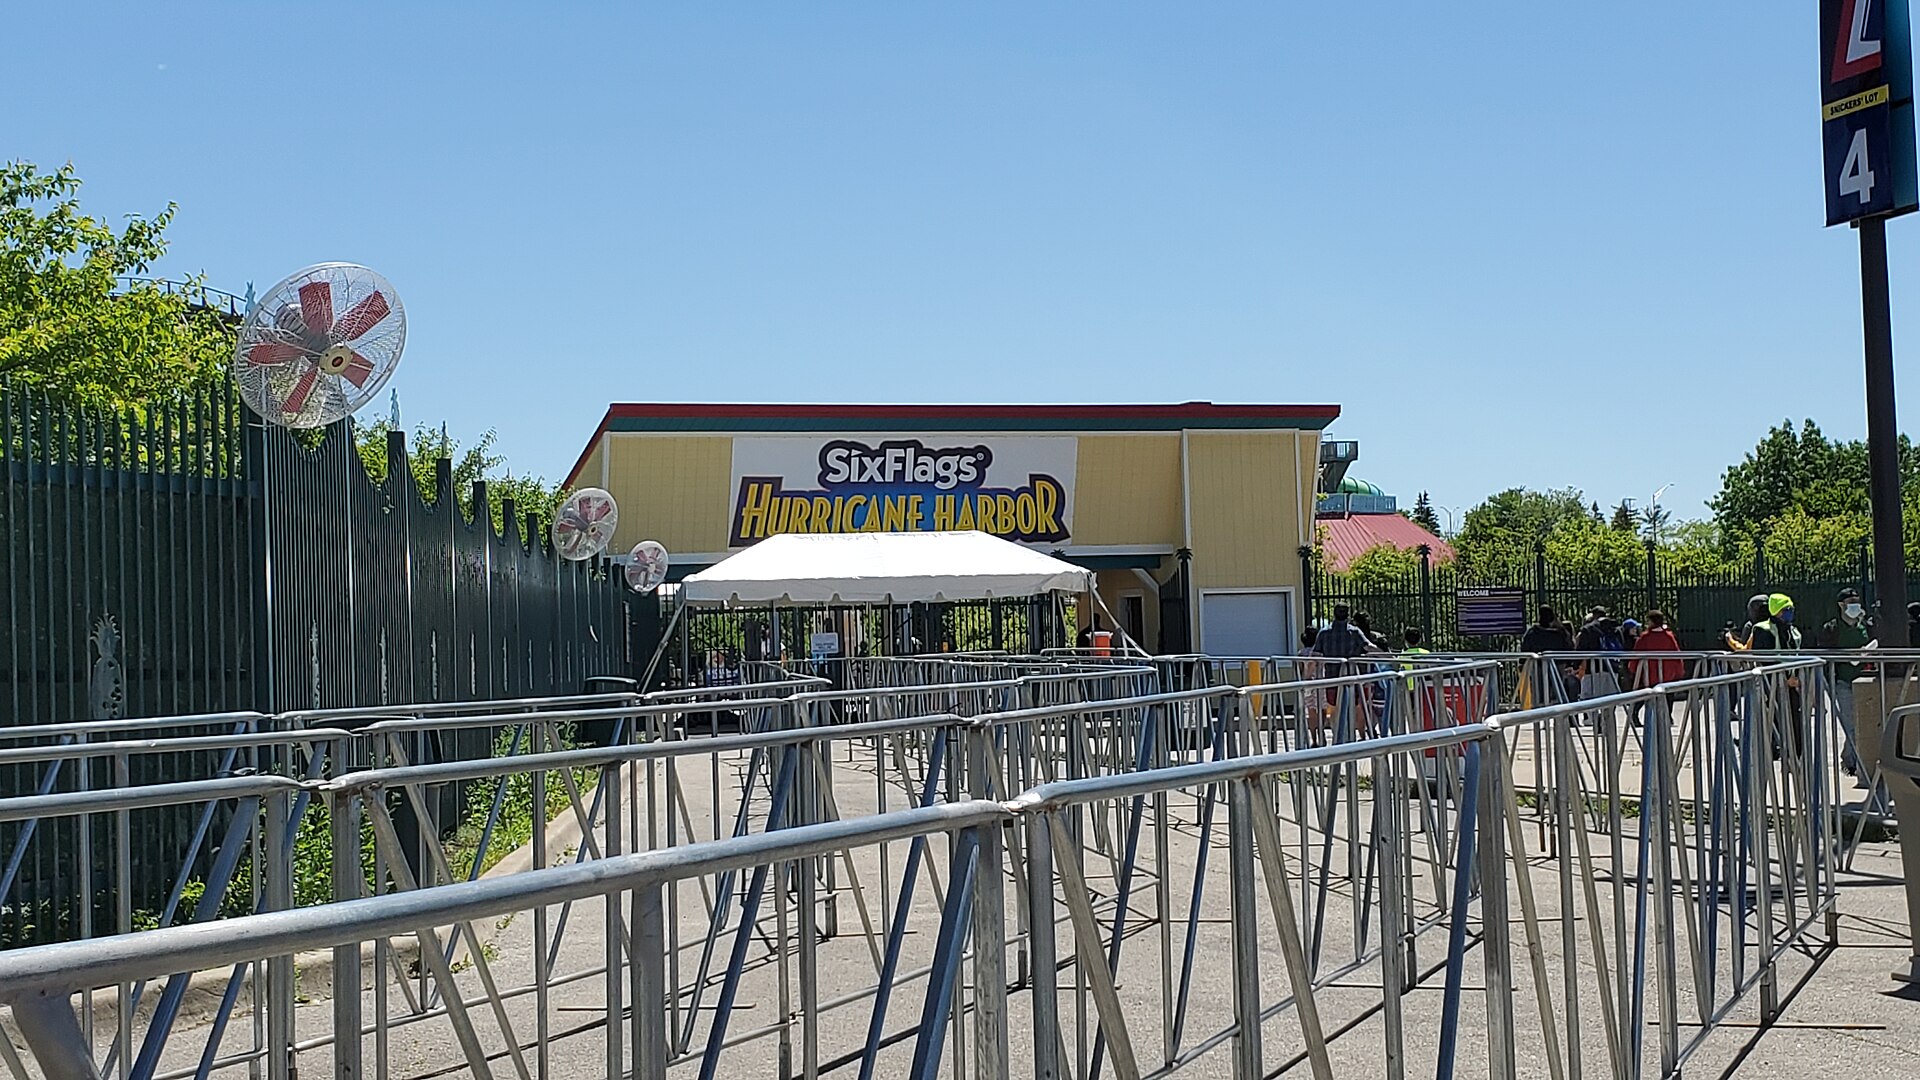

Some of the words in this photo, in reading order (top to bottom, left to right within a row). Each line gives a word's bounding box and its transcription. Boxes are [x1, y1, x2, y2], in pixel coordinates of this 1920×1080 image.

[1864, 91, 1879, 105] LOT
[1839, 127, 1875, 204] 4
[739, 483, 923, 538] HURRICANE
[933, 480, 1060, 535] HARBOR
